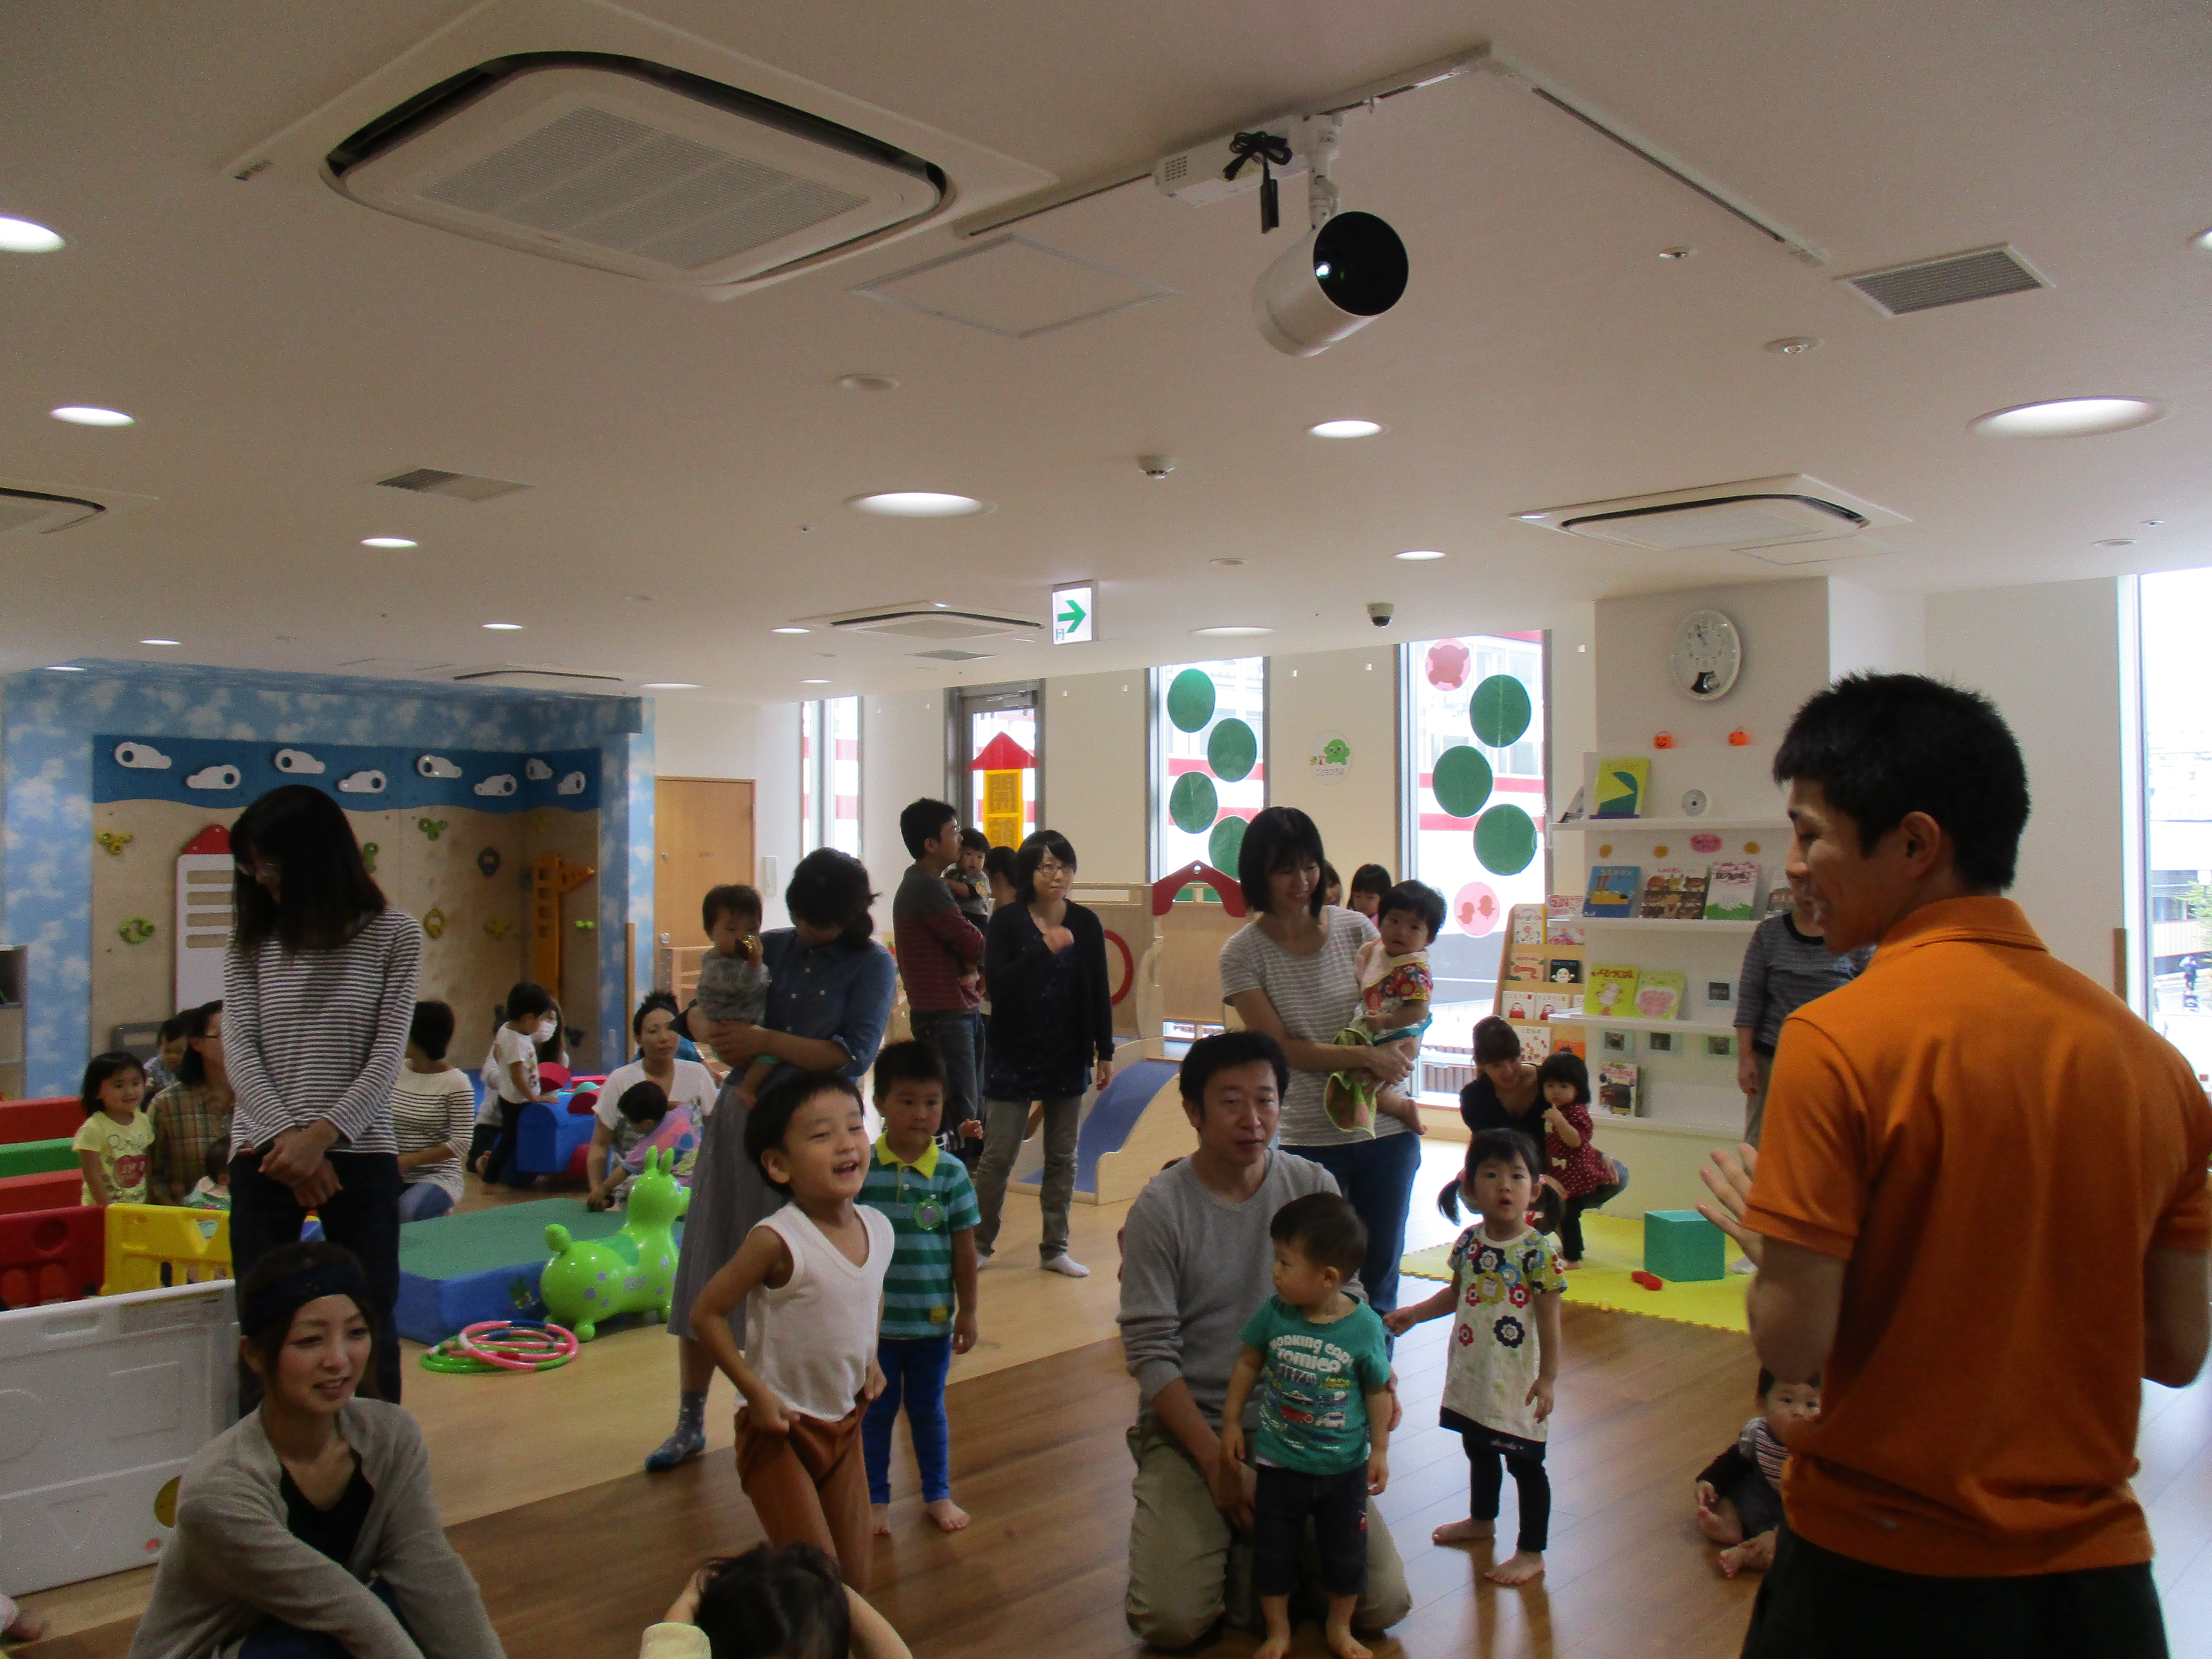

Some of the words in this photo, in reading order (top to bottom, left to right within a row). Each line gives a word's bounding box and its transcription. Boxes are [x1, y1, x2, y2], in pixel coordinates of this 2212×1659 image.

[1315, 768, 1345, 776] こどもひろば
